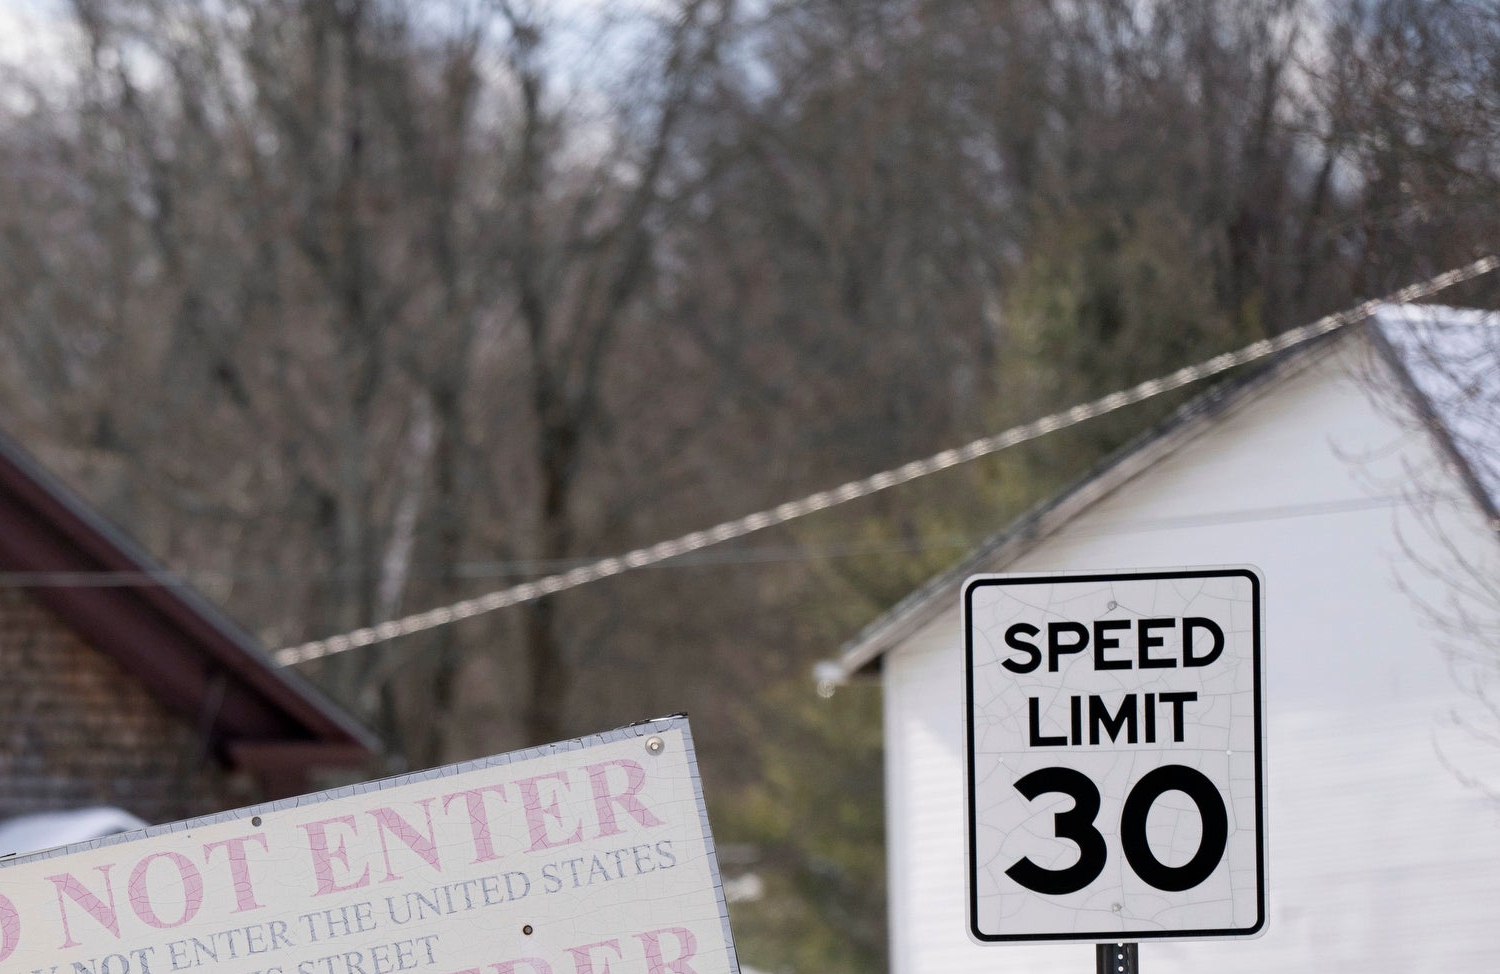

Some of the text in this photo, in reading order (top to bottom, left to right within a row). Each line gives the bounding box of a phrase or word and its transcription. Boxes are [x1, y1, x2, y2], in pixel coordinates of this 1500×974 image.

[1001, 616, 1225, 674] SPEED
[1028, 691, 1198, 747] LIMIT
[44, 832, 269, 950] NOT
[296, 758, 668, 897] ENTER
[1003, 764, 1228, 895] 30
[165, 919, 296, 972] ENTER
[299, 901, 377, 943] THE
[385, 871, 531, 925] UNITED
[541, 840, 677, 894] STATES
